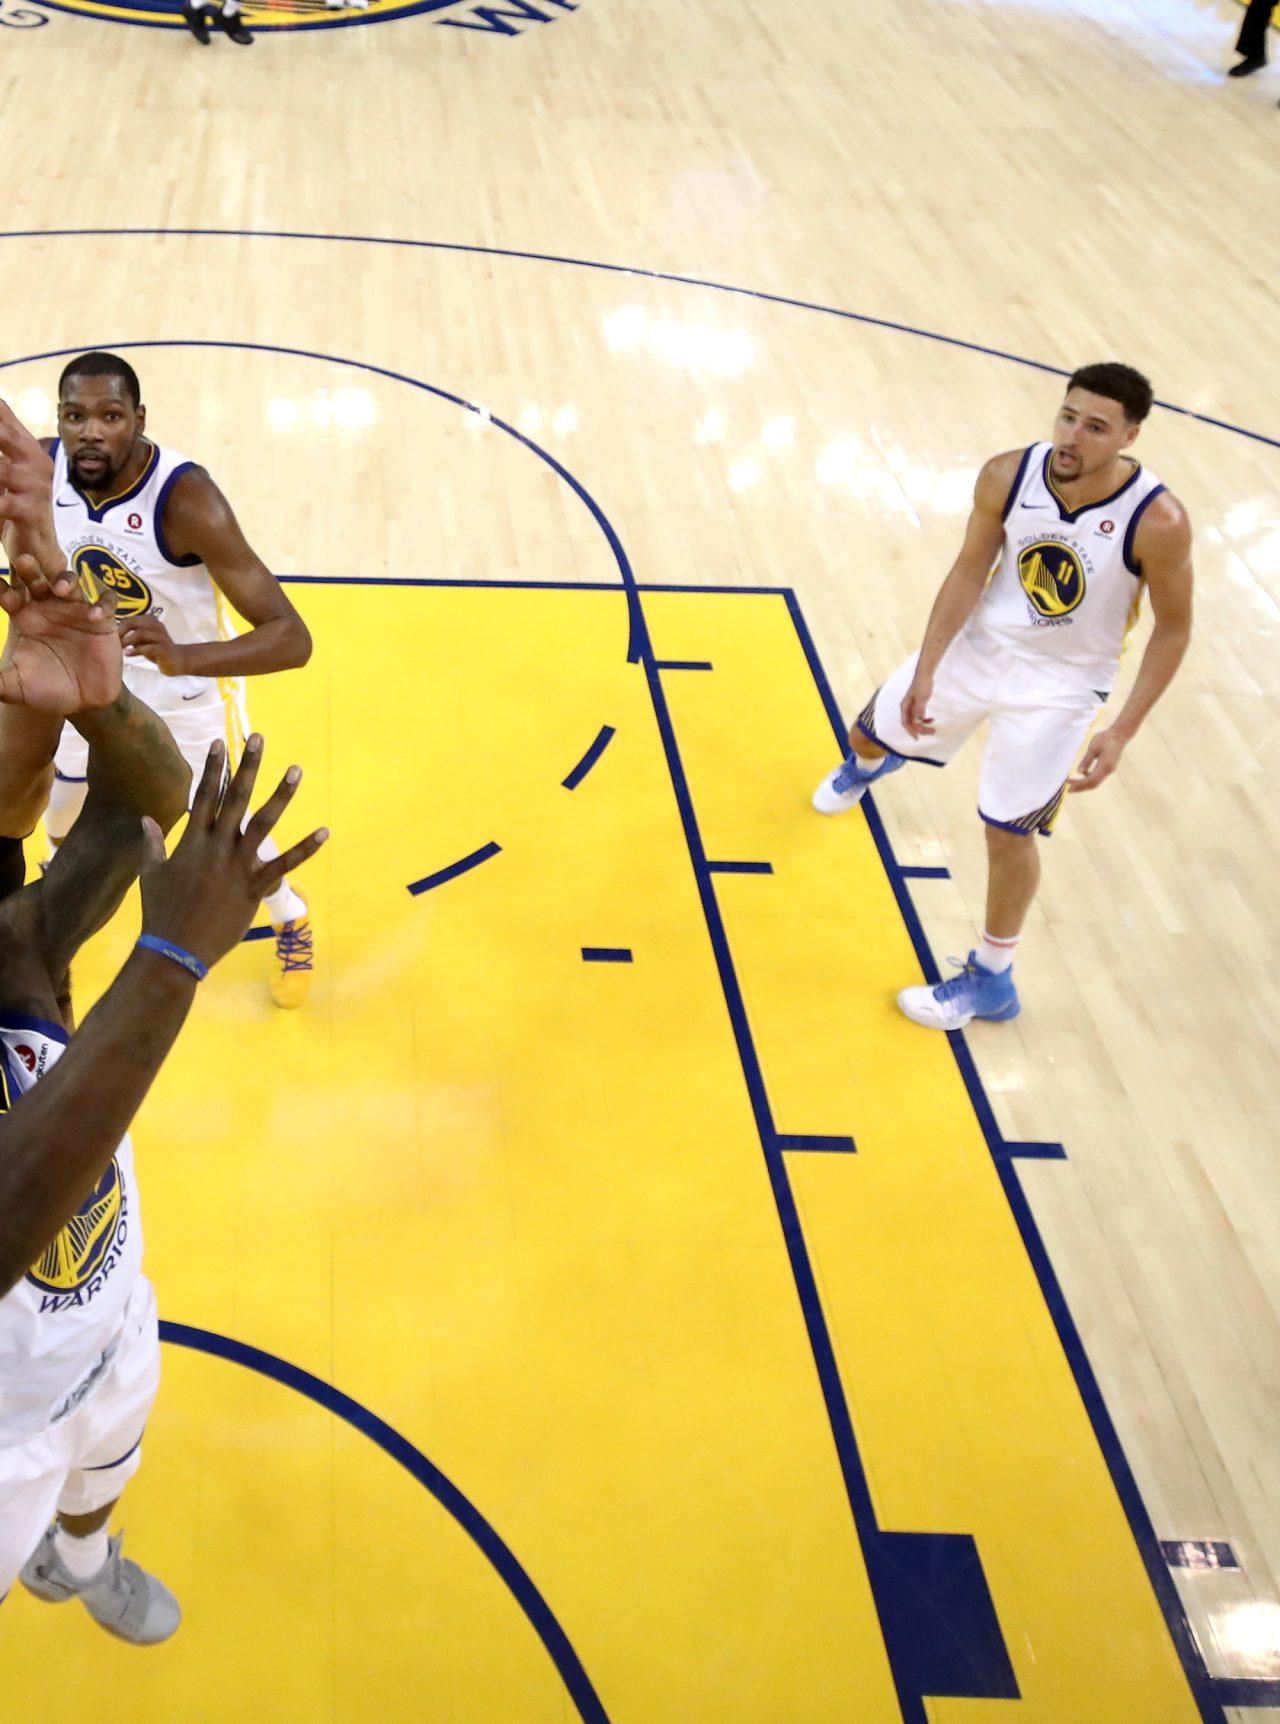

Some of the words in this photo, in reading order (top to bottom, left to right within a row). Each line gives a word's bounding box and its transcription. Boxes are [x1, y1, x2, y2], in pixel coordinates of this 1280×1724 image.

[100, 564, 131, 589] 35
[1057, 560, 1074, 586] 11
[36, 1043, 49, 1079] akuten
